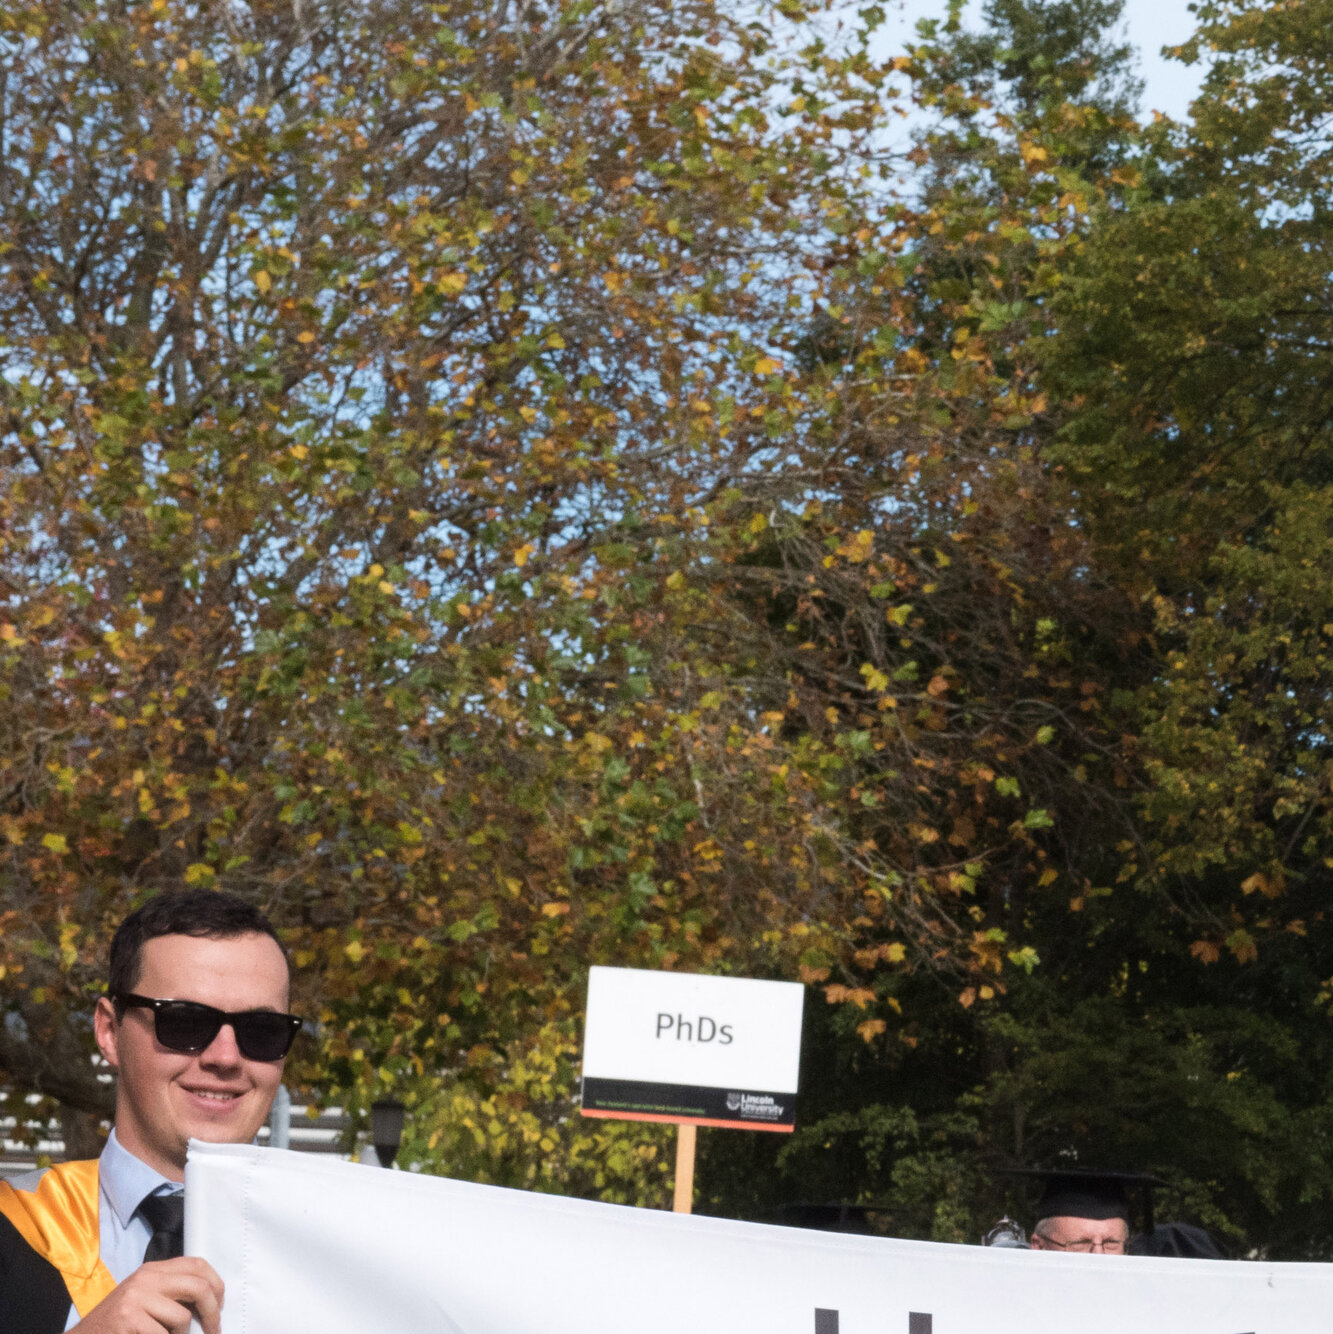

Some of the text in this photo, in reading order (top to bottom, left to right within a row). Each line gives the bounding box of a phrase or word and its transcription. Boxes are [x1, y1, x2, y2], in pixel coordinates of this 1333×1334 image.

[656, 1012, 734, 1045] PhDs
[741, 1093, 775, 1104] Lincoln
[741, 1103, 784, 1116] University
